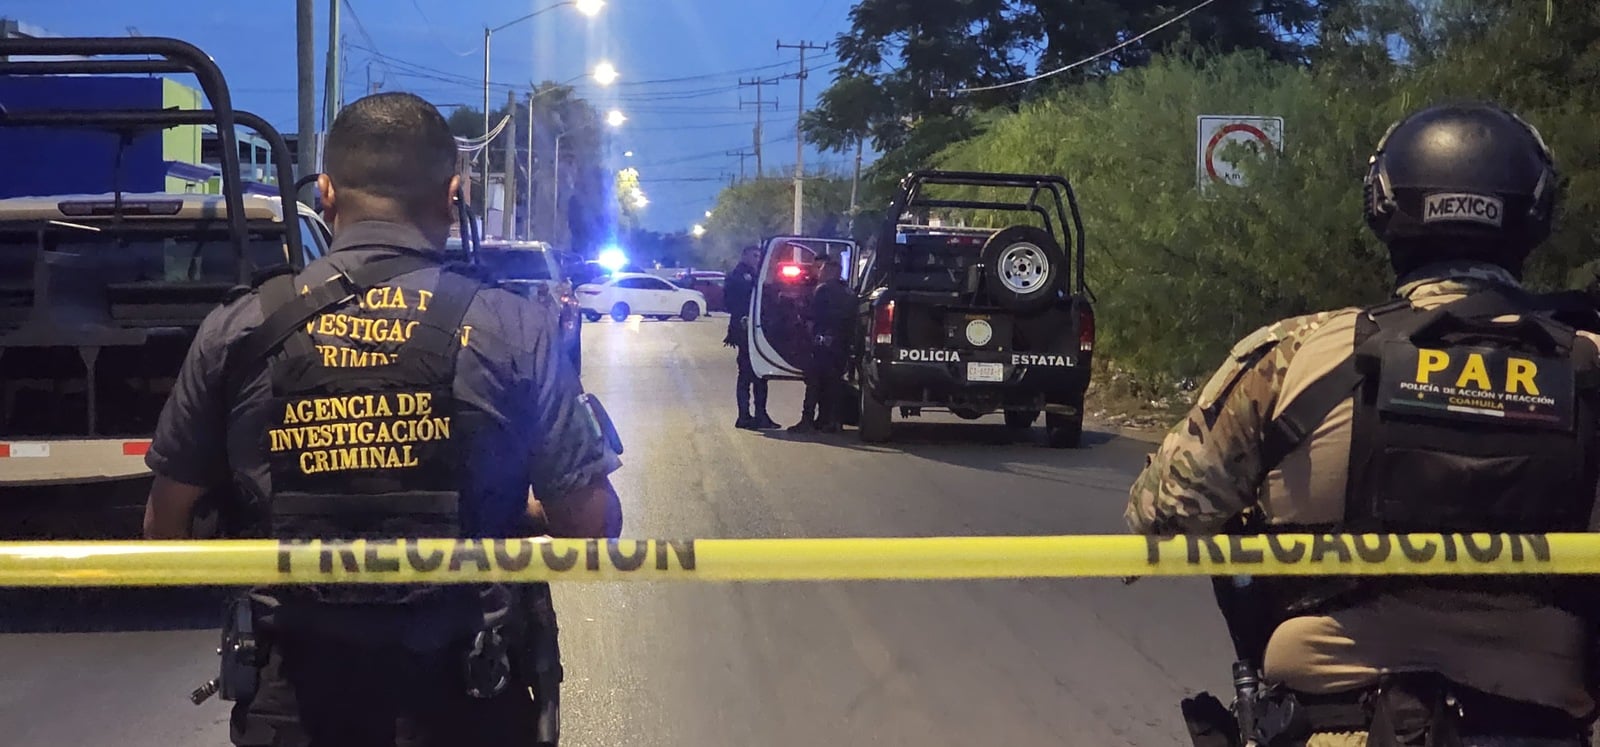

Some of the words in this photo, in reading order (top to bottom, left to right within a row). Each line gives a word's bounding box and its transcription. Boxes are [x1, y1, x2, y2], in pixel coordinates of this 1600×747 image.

[1428, 197, 1498, 219] MEXICO
[1012, 354, 1074, 367] ESTATAL
[1416, 348, 1540, 396] PAR
[1400, 382, 1440, 393] POLICÍA
[1458, 389, 1496, 399] ACCIÓN
[1505, 394, 1555, 405] REACCIÓN
[1449, 397, 1504, 409] COAHUILA
[283, 395, 392, 424] AGENCIA
[397, 392, 432, 415] DE
[269, 415, 451, 451] INVESTIGACIÓN
[300, 445, 419, 474] CRIMINAL
